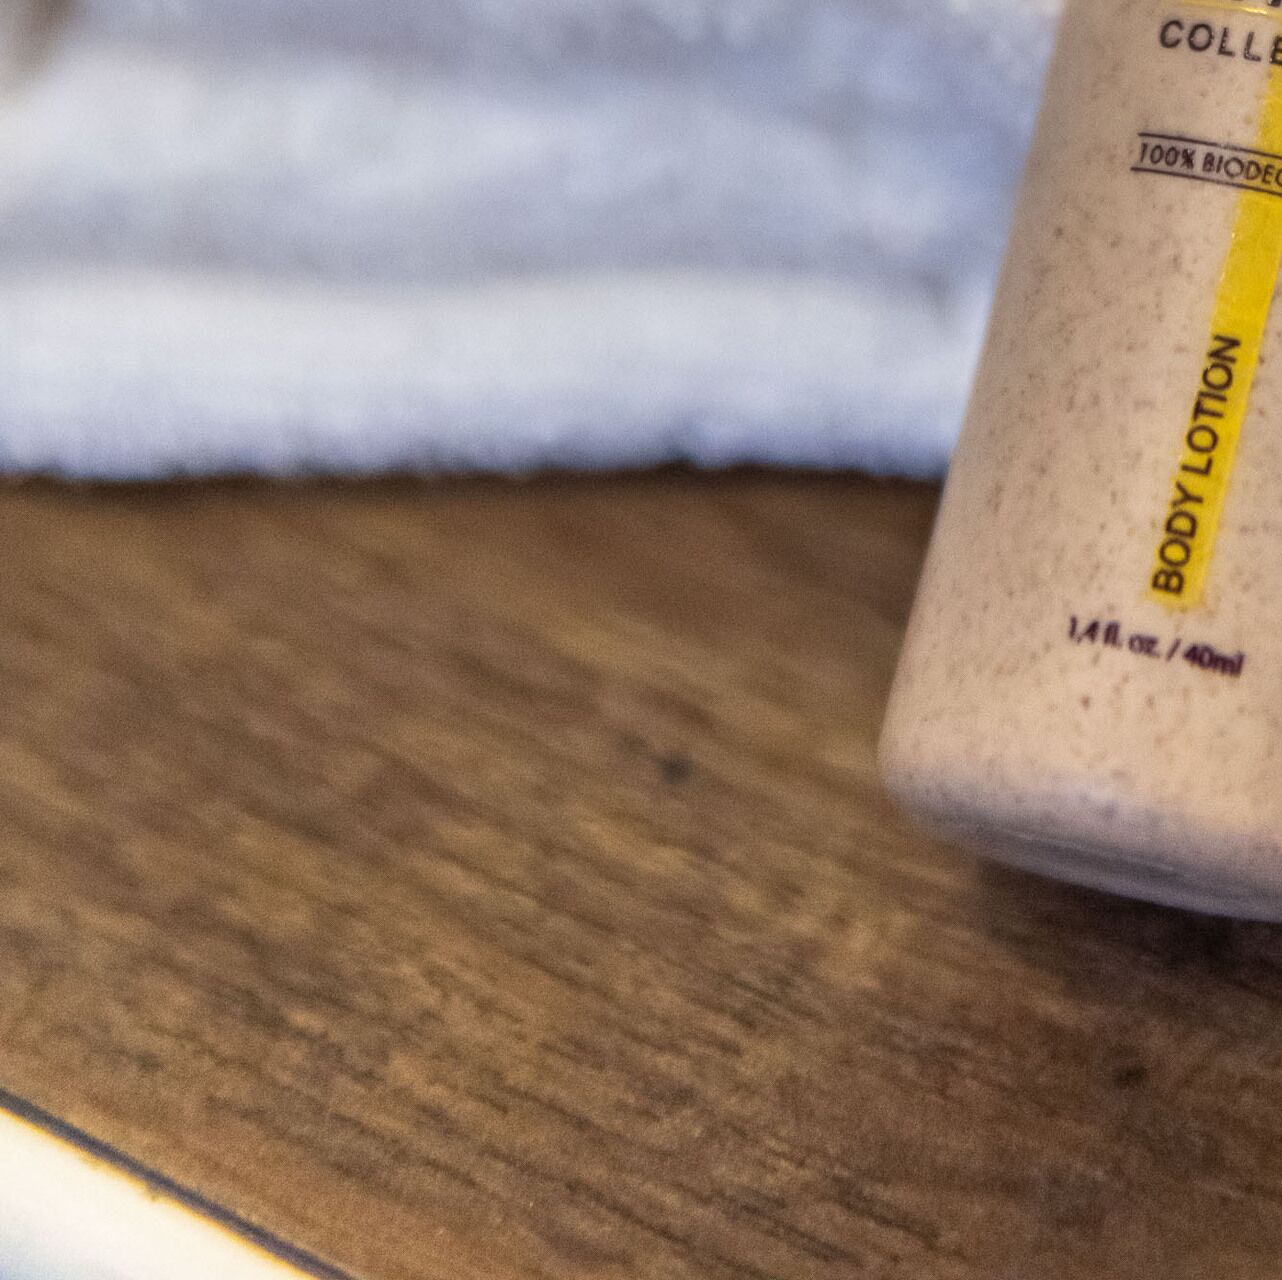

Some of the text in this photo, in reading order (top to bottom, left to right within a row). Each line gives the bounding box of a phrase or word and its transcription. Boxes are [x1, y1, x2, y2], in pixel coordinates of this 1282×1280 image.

[1139, 142, 1195, 169] 100%
[1152, 335, 1241, 596] BODY LOTION
[1182, 643, 1246, 680] 40ml
